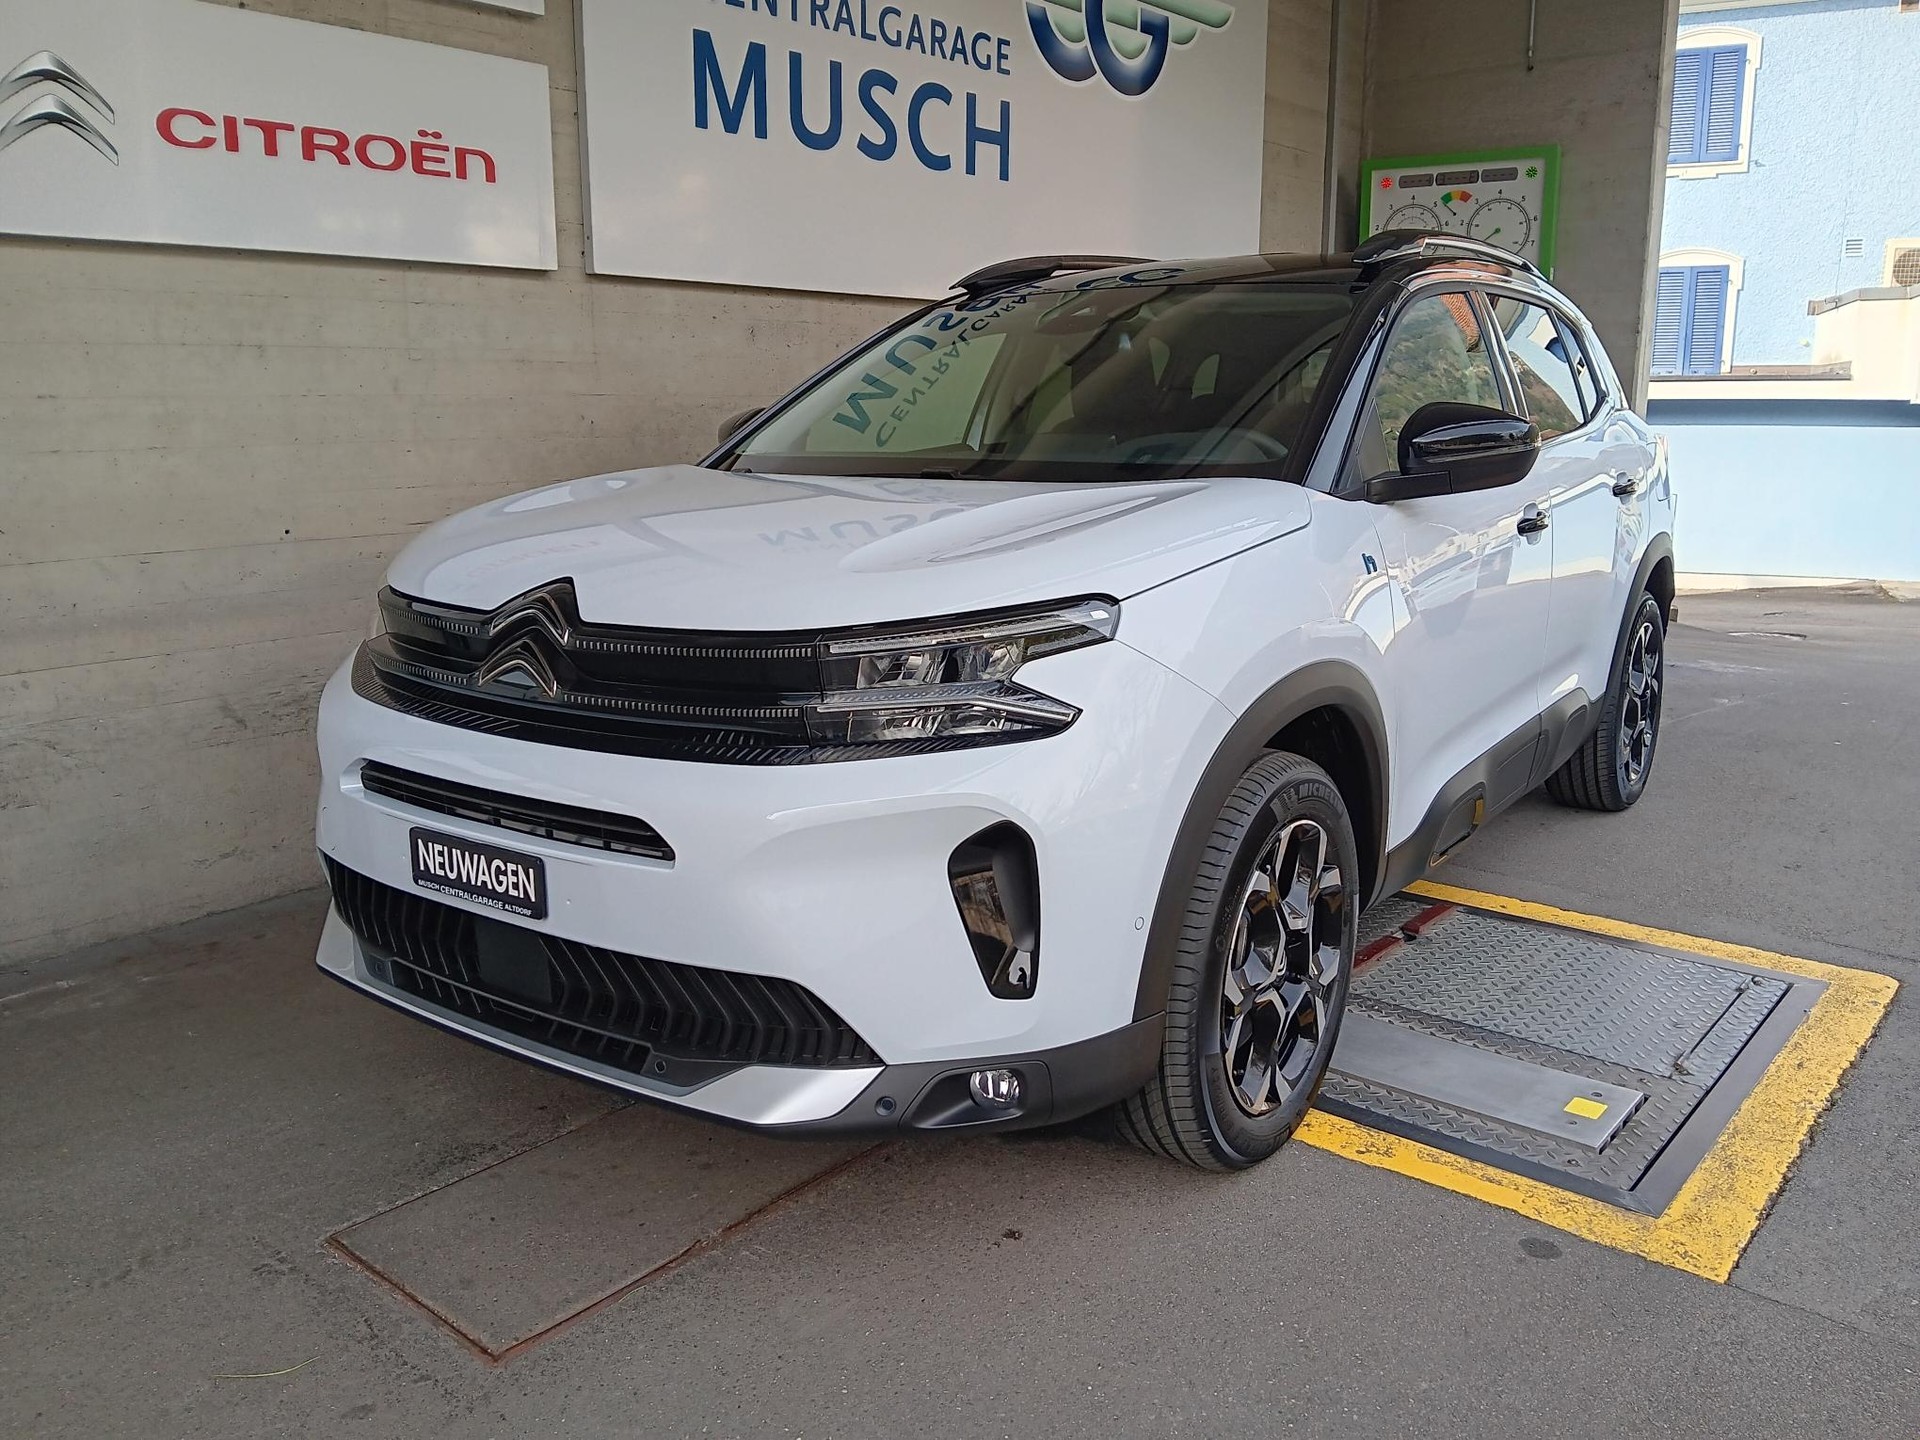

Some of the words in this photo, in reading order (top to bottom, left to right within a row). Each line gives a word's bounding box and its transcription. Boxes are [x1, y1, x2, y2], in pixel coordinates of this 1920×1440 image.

[711, 0, 1010, 76] TRALGARAGE
[693, 28, 1010, 182] MUSCH
[417, 838, 536, 902] NEUWAGEN
[418, 879, 440, 890] MUSCH
[440, 885, 504, 909] CENTRALGARAGE
[504, 904, 533, 916] ALTDORF
